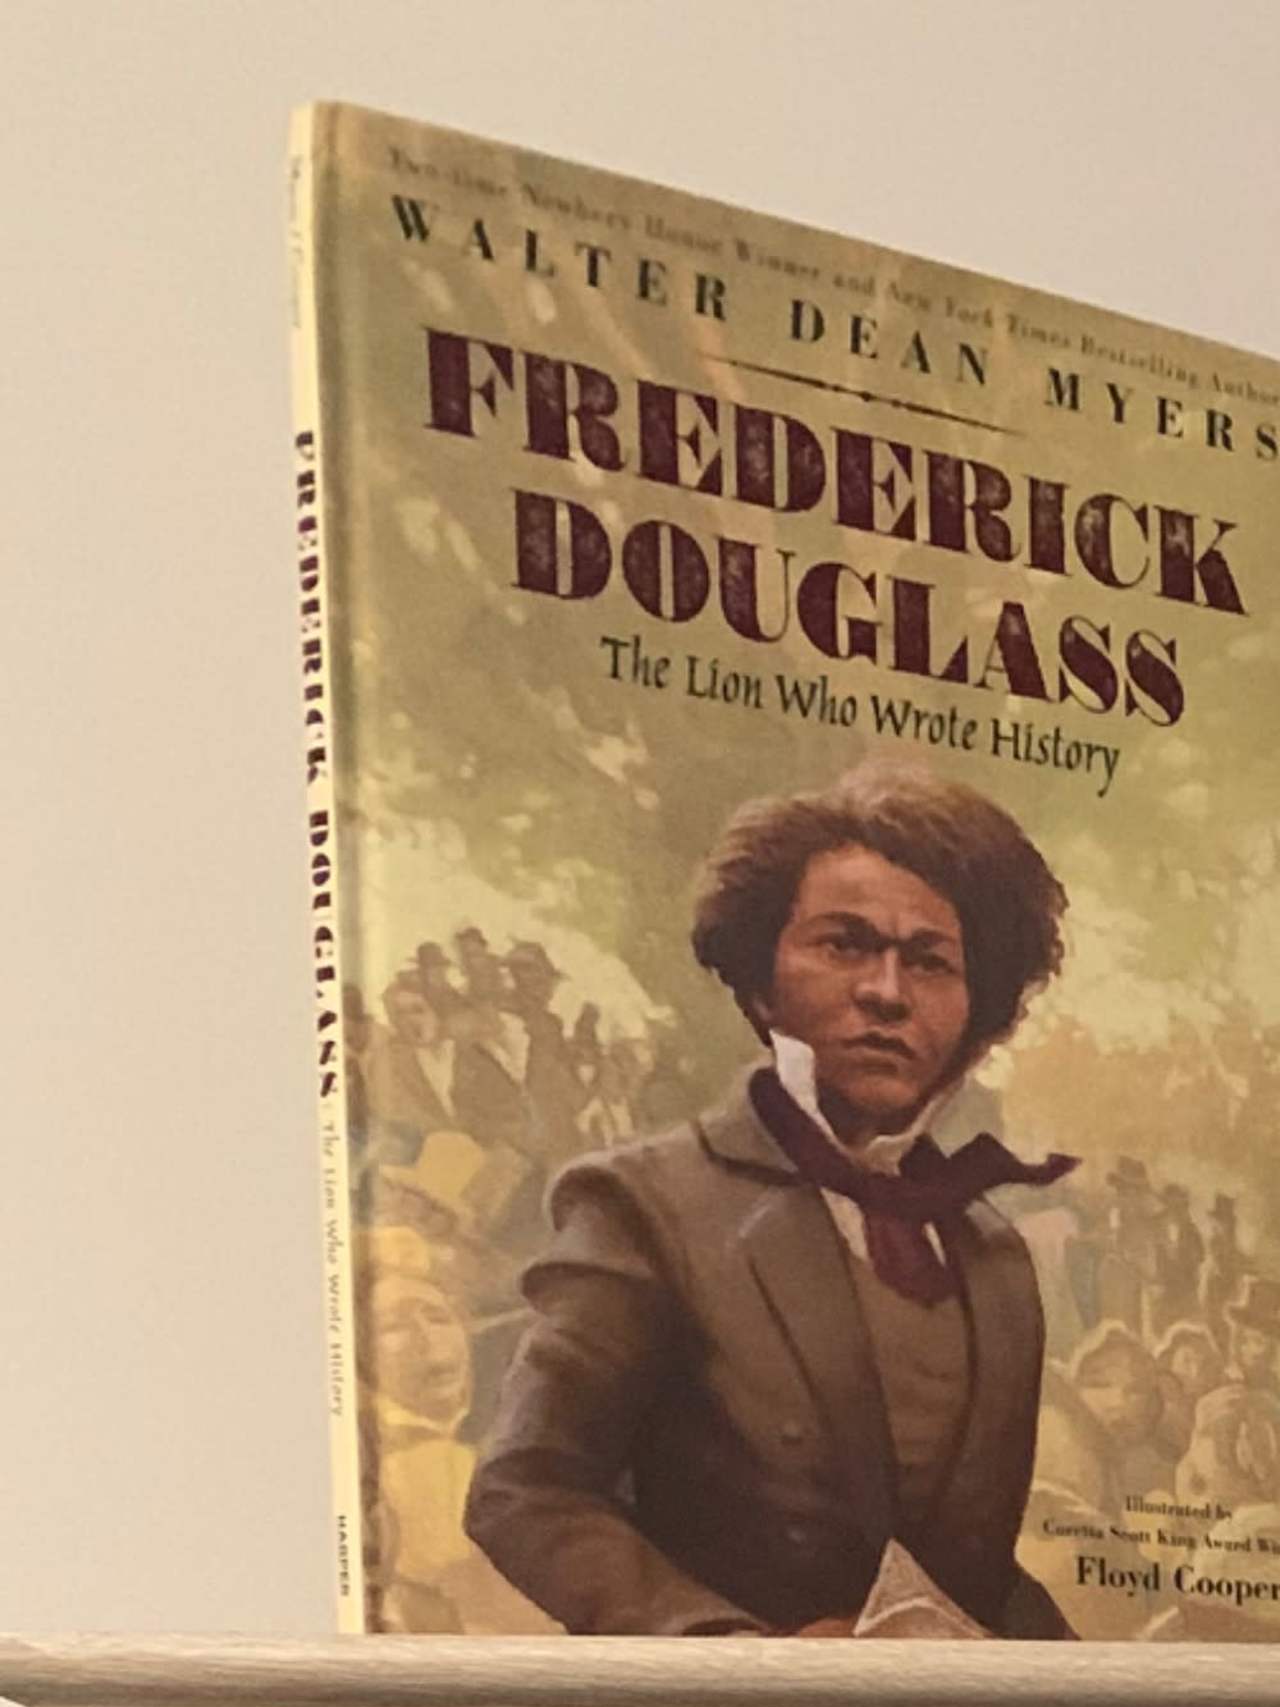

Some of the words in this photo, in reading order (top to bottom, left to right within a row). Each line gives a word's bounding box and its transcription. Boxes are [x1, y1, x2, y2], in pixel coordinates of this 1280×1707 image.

[391, 193, 727, 322] WALTER
[788, 298, 989, 387] DEAN
[1045, 366, 1280, 463] MYERS
[1007, 312, 1071, 350] Times
[1080, 334, 1200, 388] Bestselling
[1212, 371, 1280, 406] Author
[421, 325, 1248, 617] FREDERICK
[296, 430, 328, 788] FREDERICK
[510, 487, 1186, 728] DOUGLASS
[599, 634, 672, 694] The
[684, 652, 765, 711] Lion
[774, 671, 859, 731] Who
[870, 694, 977, 756] Wrote
[990, 716, 1121, 796] History
[326, 1218, 344, 1266] Who
[326, 1342, 344, 1417] History
[1125, 1494, 1212, 1521] Illustrated
[1214, 1503, 1233, 1521] by
[1203, 1533, 1252, 1554] Award
[1076, 1554, 1161, 1598] Floyd
